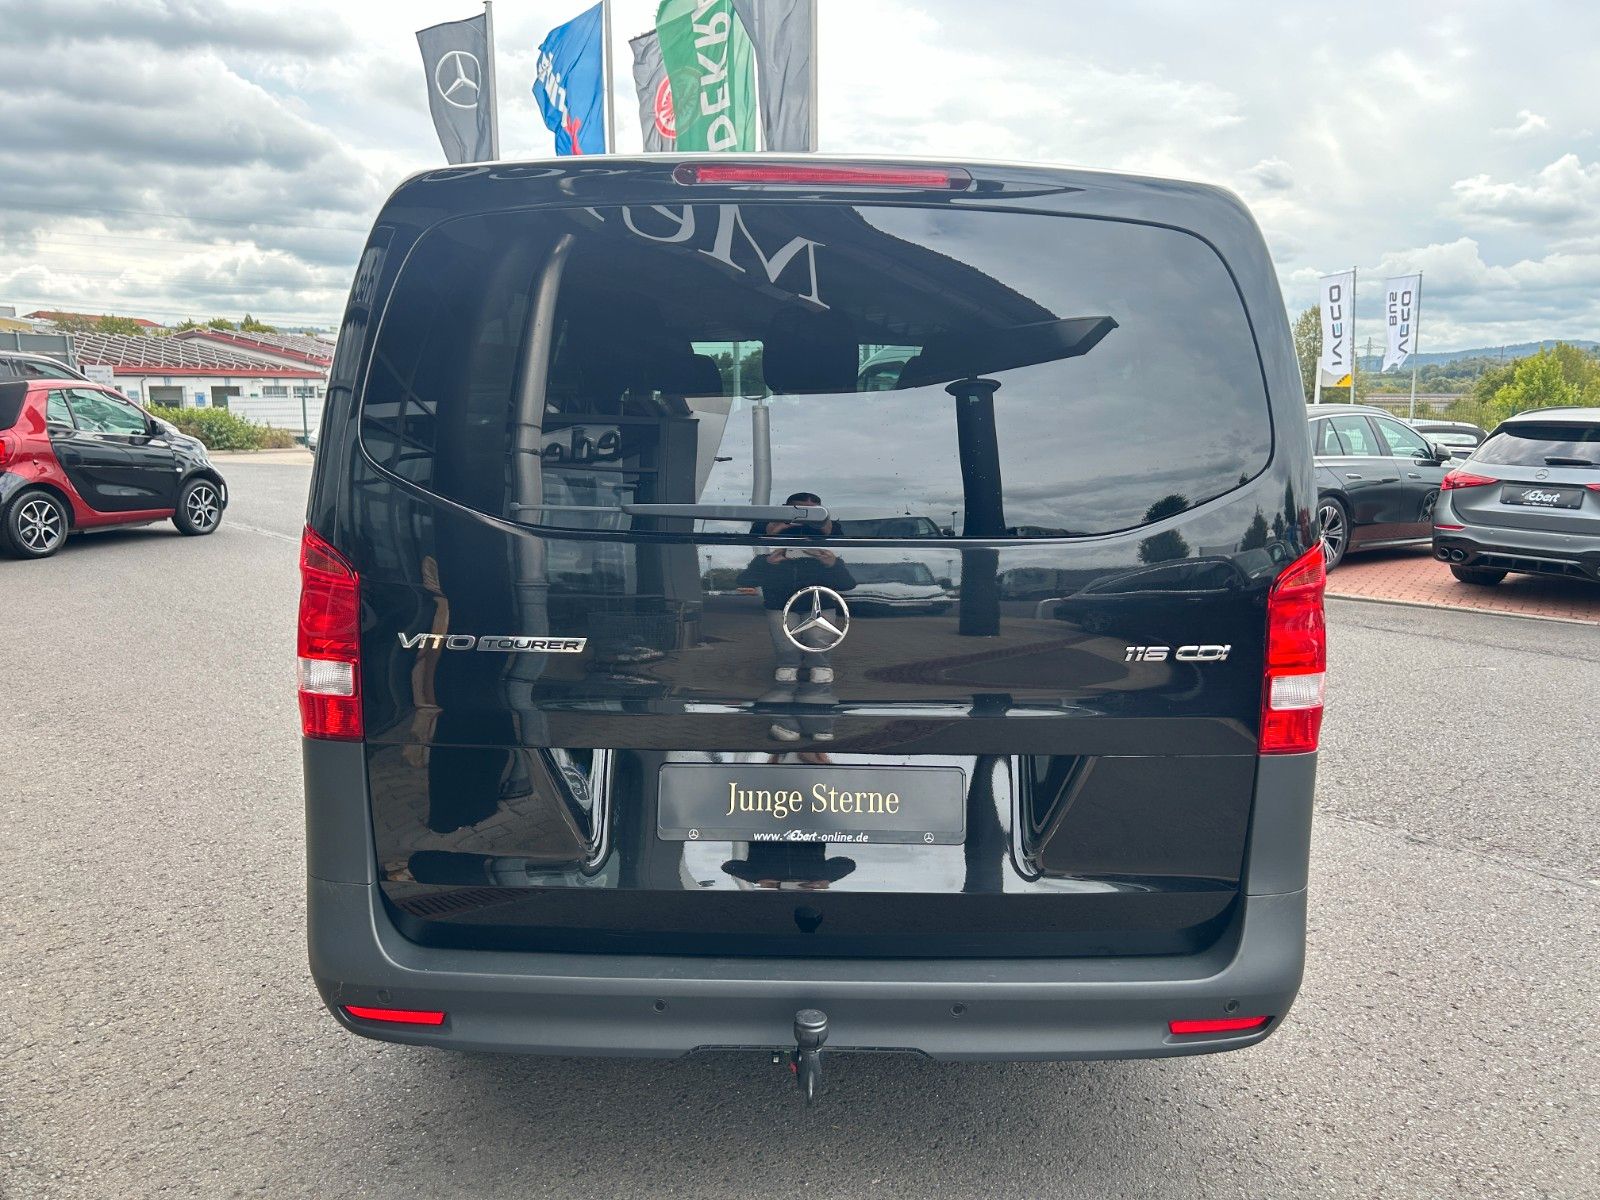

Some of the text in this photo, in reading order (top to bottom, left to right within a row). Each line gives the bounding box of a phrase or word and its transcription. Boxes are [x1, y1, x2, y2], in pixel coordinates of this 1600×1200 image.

[1528, 490, 1561, 502] Ebert
[397, 632, 580, 651] VITO TOURER
[1124, 646, 1170, 661] 116
[726, 782, 900, 818] Junge Sterne
